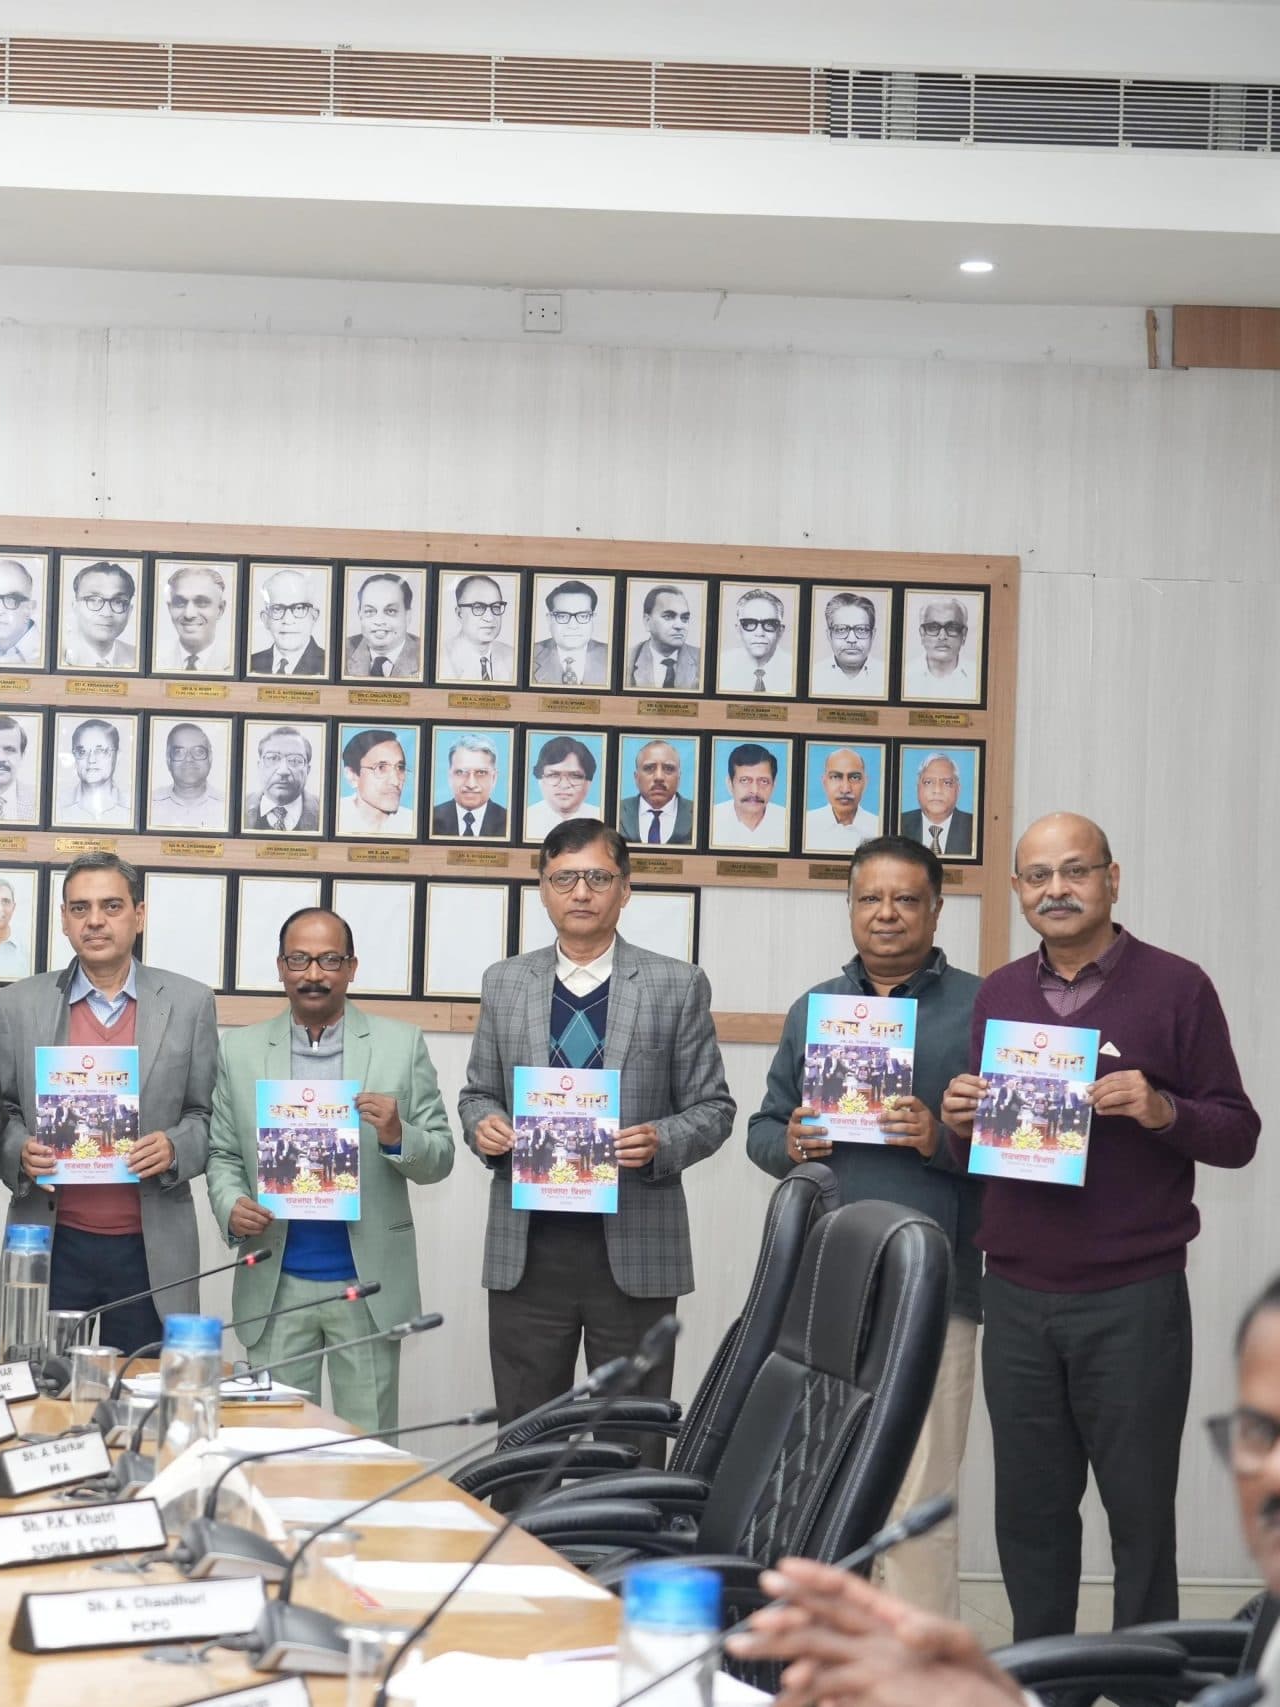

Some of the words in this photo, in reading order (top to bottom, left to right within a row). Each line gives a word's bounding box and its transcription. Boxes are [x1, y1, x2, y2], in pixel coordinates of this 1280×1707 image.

[22, 1450, 38, 1462] Sh.
[53, 1440, 86, 1455] Sarkar
[49, 1462, 70, 1475] PFA
[22, 1519, 41, 1533] Sh.
[47, 1515, 71, 1530] P.K.
[76, 1509, 116, 1526] Khatri
[32, 1541, 70, 1556] SDGM
[77, 1539, 85, 1551] &
[90, 1535, 119, 1551] CVO
[87, 1598, 108, 1612] Sh.
[133, 1592, 206, 1610] Chaudhuri
[130, 1619, 171, 1633] PCPO
